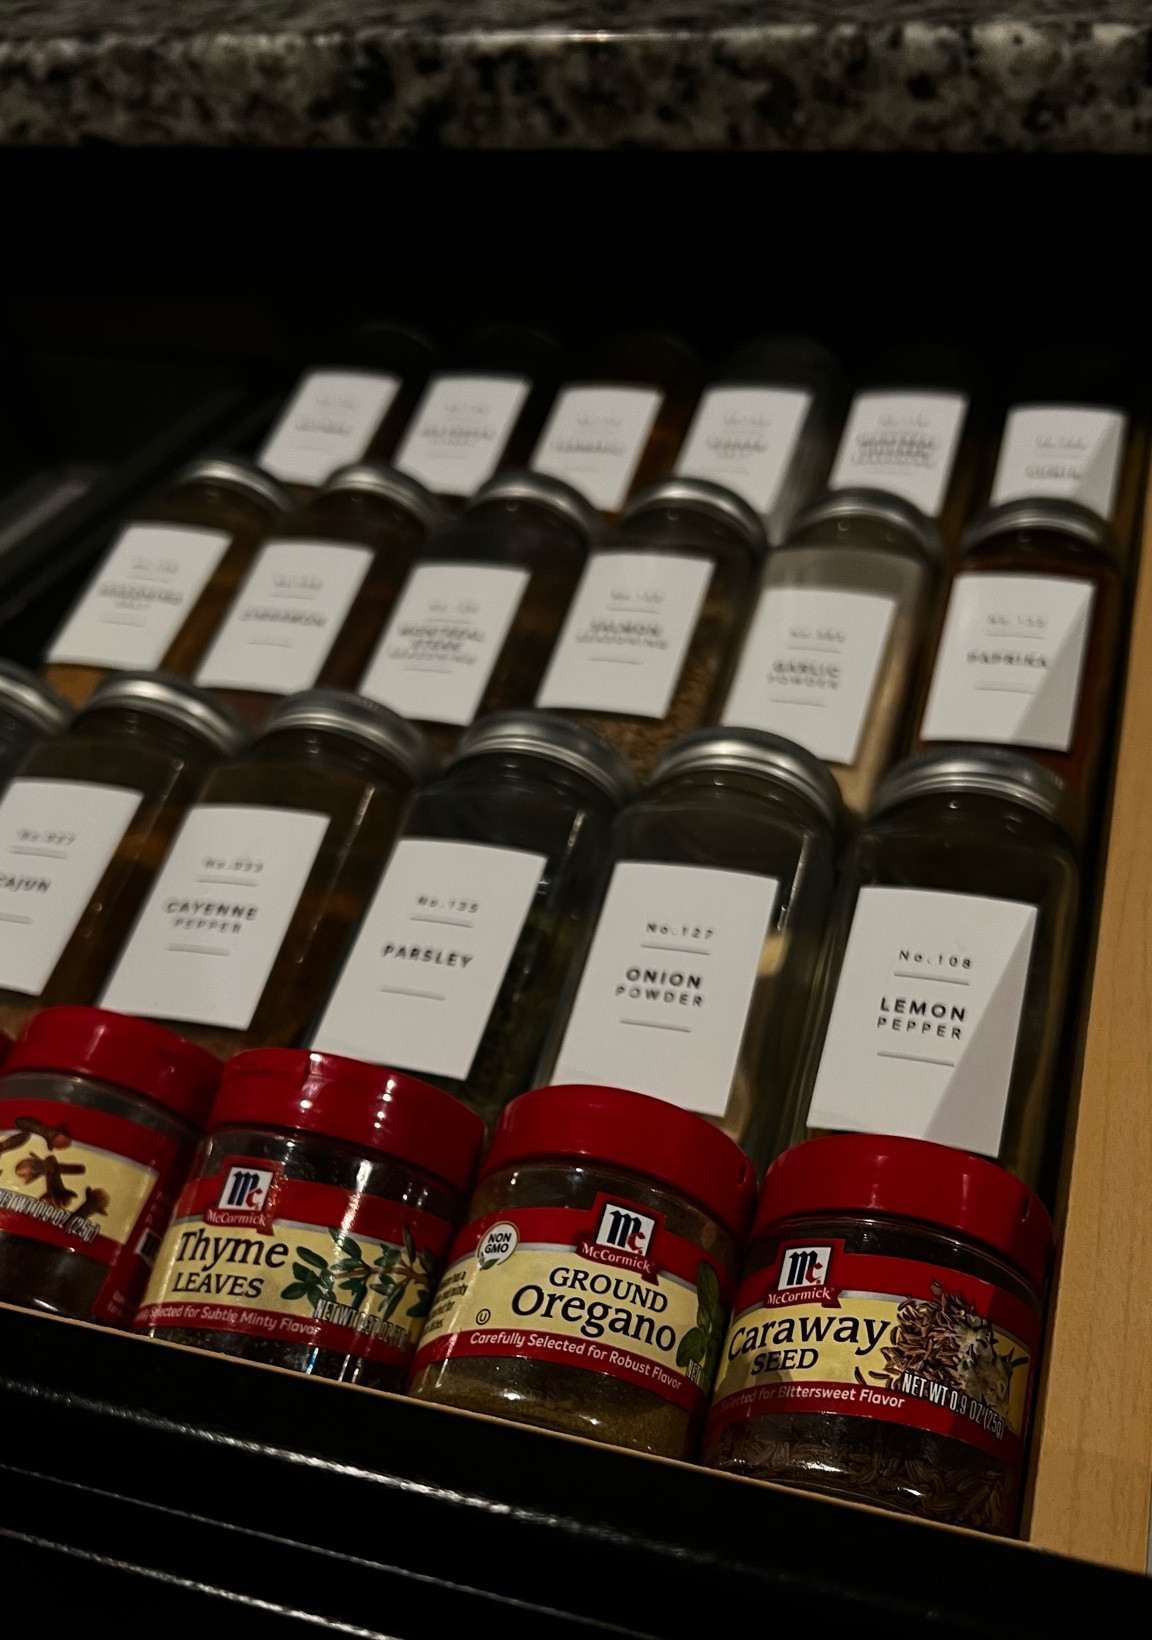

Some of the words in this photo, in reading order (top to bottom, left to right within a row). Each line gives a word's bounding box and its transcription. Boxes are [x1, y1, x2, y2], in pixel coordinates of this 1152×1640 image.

[772, 659, 840, 678] GARLIC
[967, 649, 1046, 667] PAPRIKA
[166, 899, 259, 922] CAYENNE
[172, 917, 242, 935] PEPPER
[646, 921, 714, 941] No.127
[381, 943, 473, 970] PARSLEY
[899, 949, 972, 970] No.108
[626, 966, 703, 990] ONION
[616, 984, 704, 1009] POWDER
[880, 996, 966, 1022] LEMON
[877, 1016, 962, 1041] PEPPER
[207, 1208, 267, 1228] McCormick
[175, 1227, 289, 1272] Thyme
[484, 1242, 510, 1255] GMO
[488, 1231, 512, 1244] NON
[581, 1242, 651, 1274] McCormick
[171, 1271, 265, 1299] LEAVES
[549, 1266, 668, 1314] GROUND
[767, 1286, 832, 1305] McCormick
[184, 1304, 200, 1319] for
[200, 1305, 238, 1324] Subtle
[239, 1311, 279, 1332] Minty
[279, 1316, 321, 1337] Flavor
[313, 1298, 338, 1322] NET
[511, 1284, 677, 1352] Oregano
[728, 1315, 891, 1362] Caraway
[470, 1331, 526, 1349] Carefully
[527, 1333, 584, 1355] Selected
[586, 1344, 608, 1361] for
[609, 1350, 651, 1377] Robust
[651, 1366, 682, 1390] Flavor
[751, 1348, 819, 1375] SEED
[758, 1387, 777, 1401] for
[777, 1384, 856, 1402] Bittersweet
[859, 1387, 905, 1409] Flavor
[902, 1371, 927, 1398] NET
[929, 1380, 949, 1406] WT
[949, 1389, 968, 1416] 0.9
[969, 1400, 983, 1424] OZ
